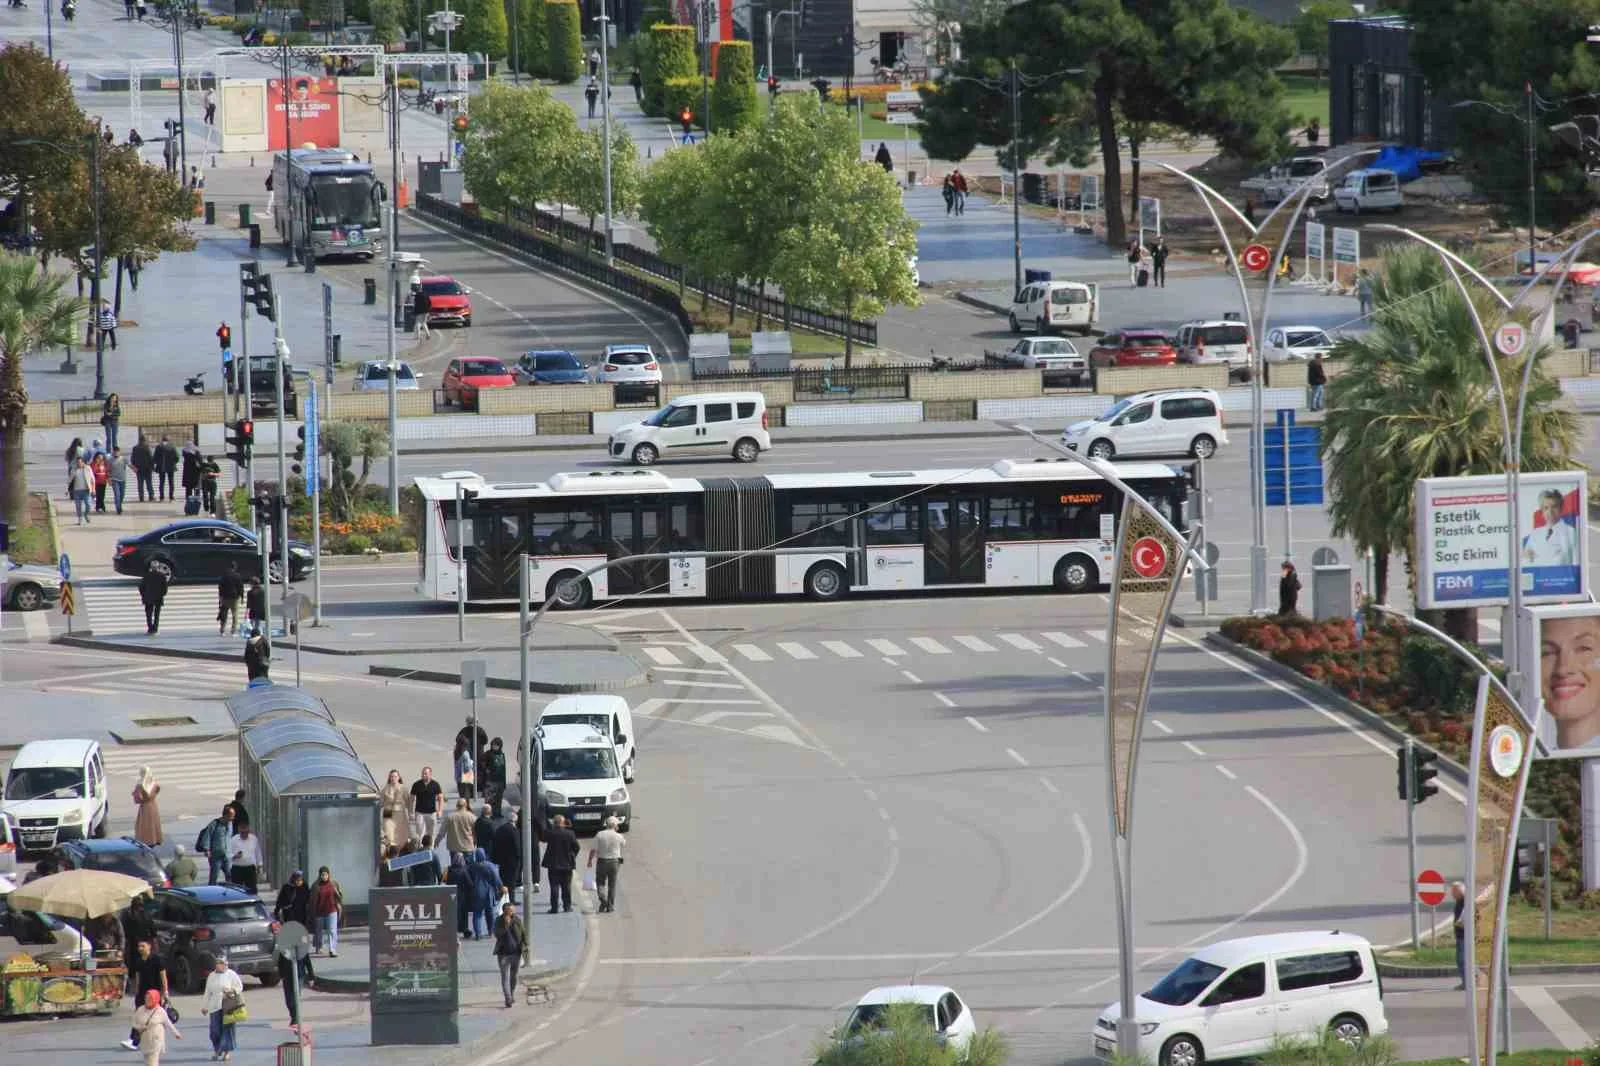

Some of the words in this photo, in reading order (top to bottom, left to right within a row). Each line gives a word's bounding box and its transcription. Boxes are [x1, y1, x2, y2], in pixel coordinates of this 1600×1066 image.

[1434, 509, 1481, 524] Estetik
[1435, 525, 1475, 537] Plastik
[1477, 523, 1512, 535] Cerra
[1435, 551, 1460, 565] Saç
[1463, 548, 1498, 562] Ekimi
[1436, 575, 1474, 590] FBM
[384, 903, 442, 920] YALI
